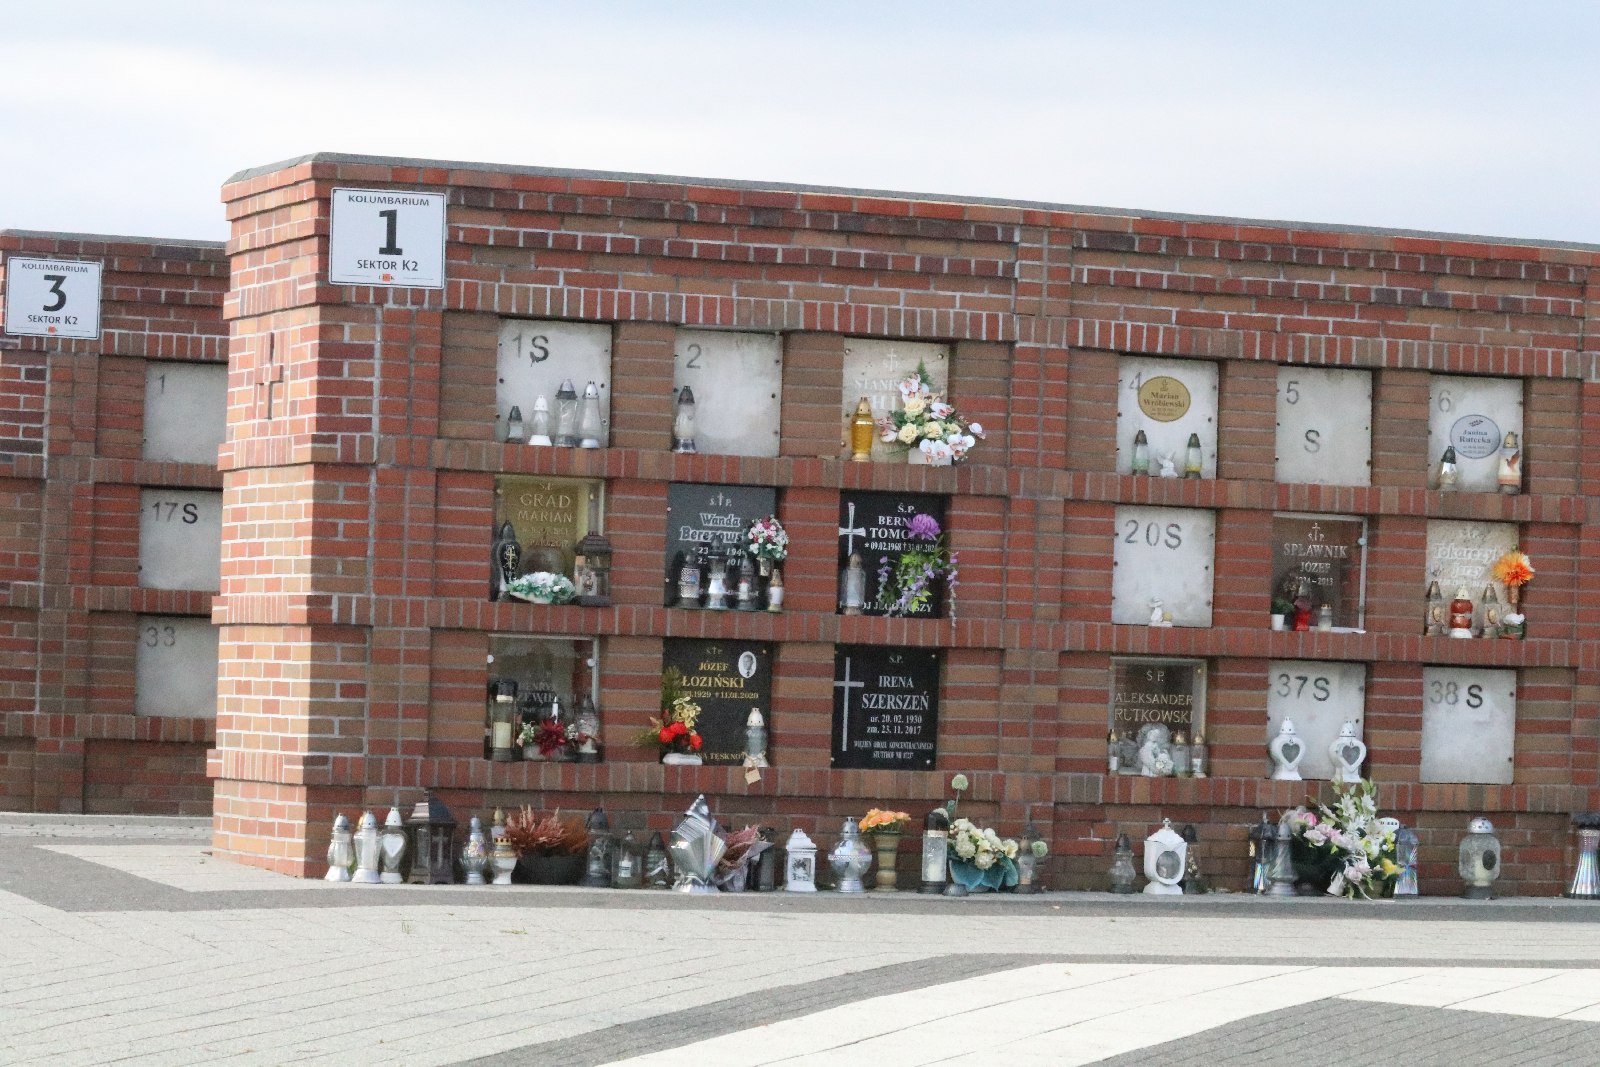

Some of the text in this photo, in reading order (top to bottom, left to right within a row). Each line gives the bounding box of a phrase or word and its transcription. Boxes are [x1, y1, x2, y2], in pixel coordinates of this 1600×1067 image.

[348, 194, 430, 206] KOLUMBARIUM
[378, 209, 403, 256] 1
[21, 262, 89, 273] KOLUMBARIUM
[357, 259, 418, 272] SEKTOR K2
[42, 274, 68, 312] 3
[28, 314, 78, 325] SEKTOR K2
[686, 343, 702, 369] 2
[158, 374, 166, 395] 1
[1286, 380, 1300, 405] 5
[1438, 389, 1451, 413] 6
[1304, 429, 1320, 453] S
[520, 493, 571, 508] GRAD
[518, 510, 573, 523] MARIAN
[699, 513, 741, 527] Wanda
[878, 515, 912, 526] BERN
[679, 525, 746, 543] Berezows
[869, 527, 911, 540] TOMC
[145, 626, 176, 648] 33
[699, 659, 730, 671] JÓZEF
[681, 673, 746, 688] ŁOZIŃSKI
[879, 675, 914, 688] IRENA
[862, 691, 930, 711] SZERSZEŃ
[1114, 692, 1193, 706] ALEKSANDER
[906, 715, 922, 724] 1930
[1114, 708, 1193, 723] RUTKOWSKI
[866, 726, 880, 734] zm.
[905, 726, 922, 735] 2017
[709, 752, 745, 761] TĘSKNOT
